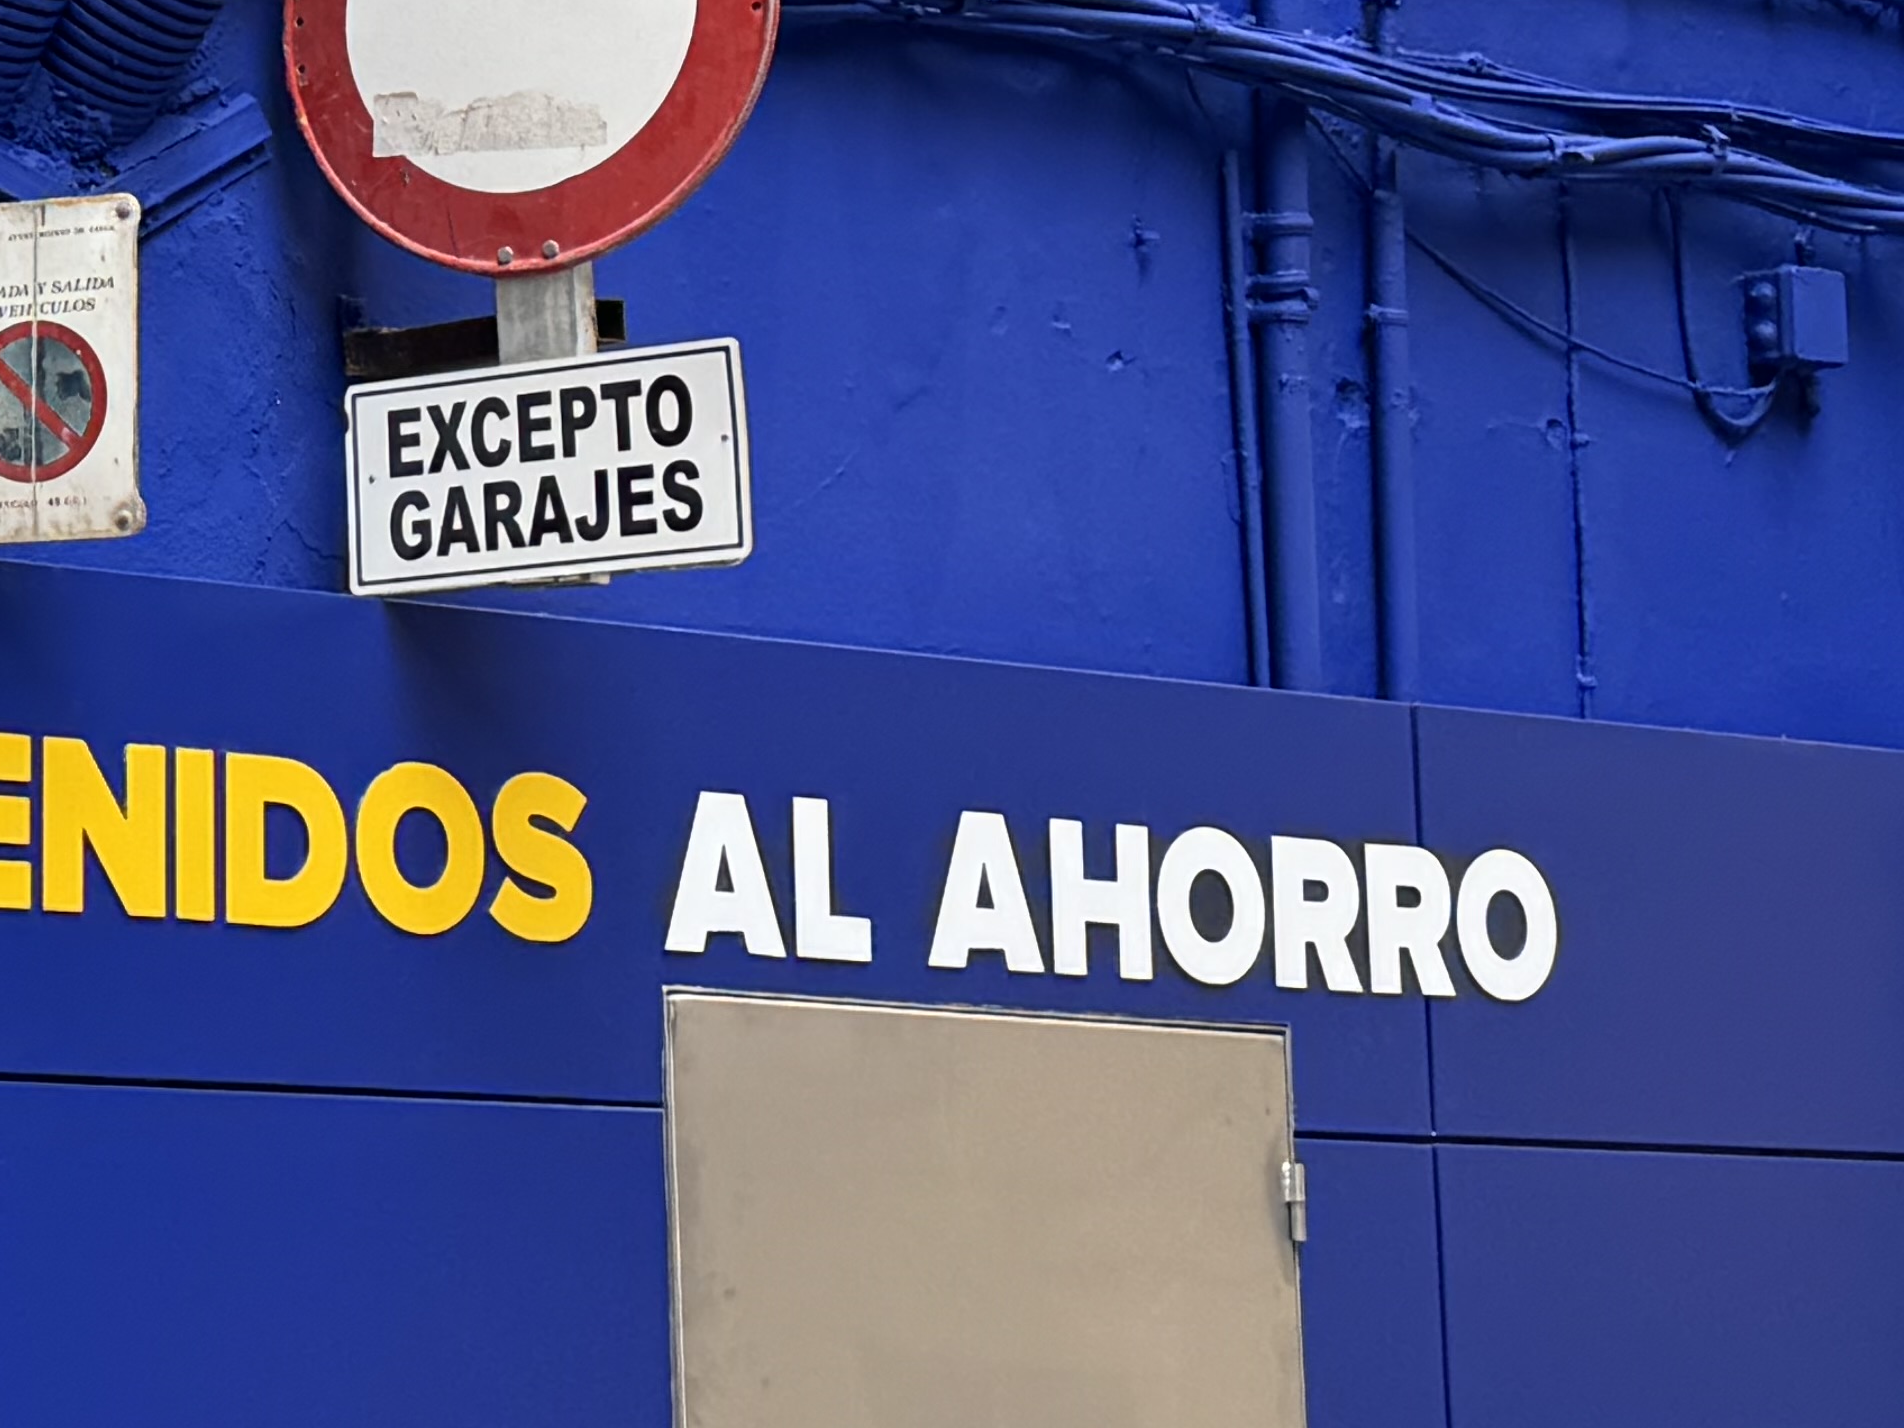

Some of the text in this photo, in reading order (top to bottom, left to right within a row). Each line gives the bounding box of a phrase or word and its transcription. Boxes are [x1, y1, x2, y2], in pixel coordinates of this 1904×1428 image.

[51, 275, 115, 294] SALIDA
[387, 374, 692, 478] EXCEPTO
[391, 459, 704, 561] GARAJES
[664, 790, 873, 963] AL
[927, 809, 1558, 1003] AHORRO
